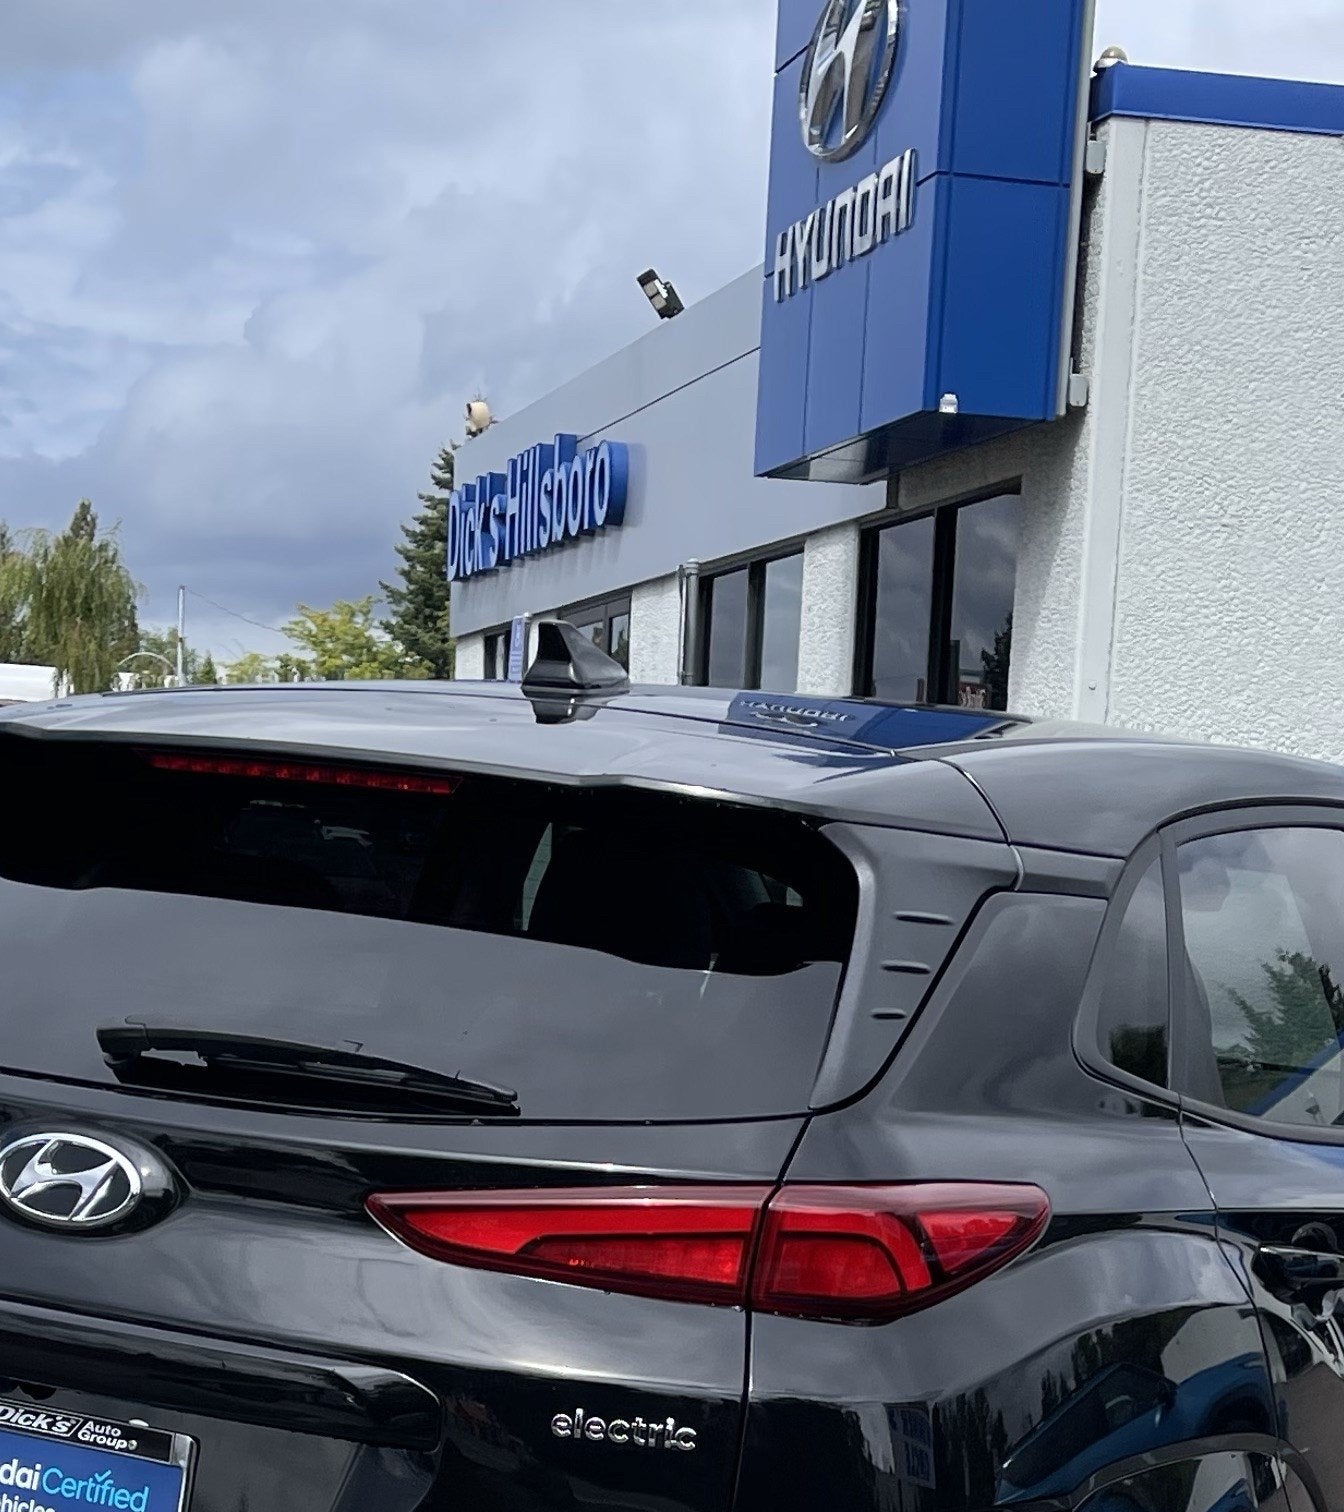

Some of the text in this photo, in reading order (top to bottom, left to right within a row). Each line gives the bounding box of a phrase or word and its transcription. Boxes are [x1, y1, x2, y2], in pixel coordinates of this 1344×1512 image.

[774, 148, 916, 303] HYUNDAI
[447, 433, 616, 582] Dick's Hillsboro
[77, 1429, 129, 1450] Group
[82, 1420, 122, 1437] Auto
[551, 1407, 698, 1451] electric
